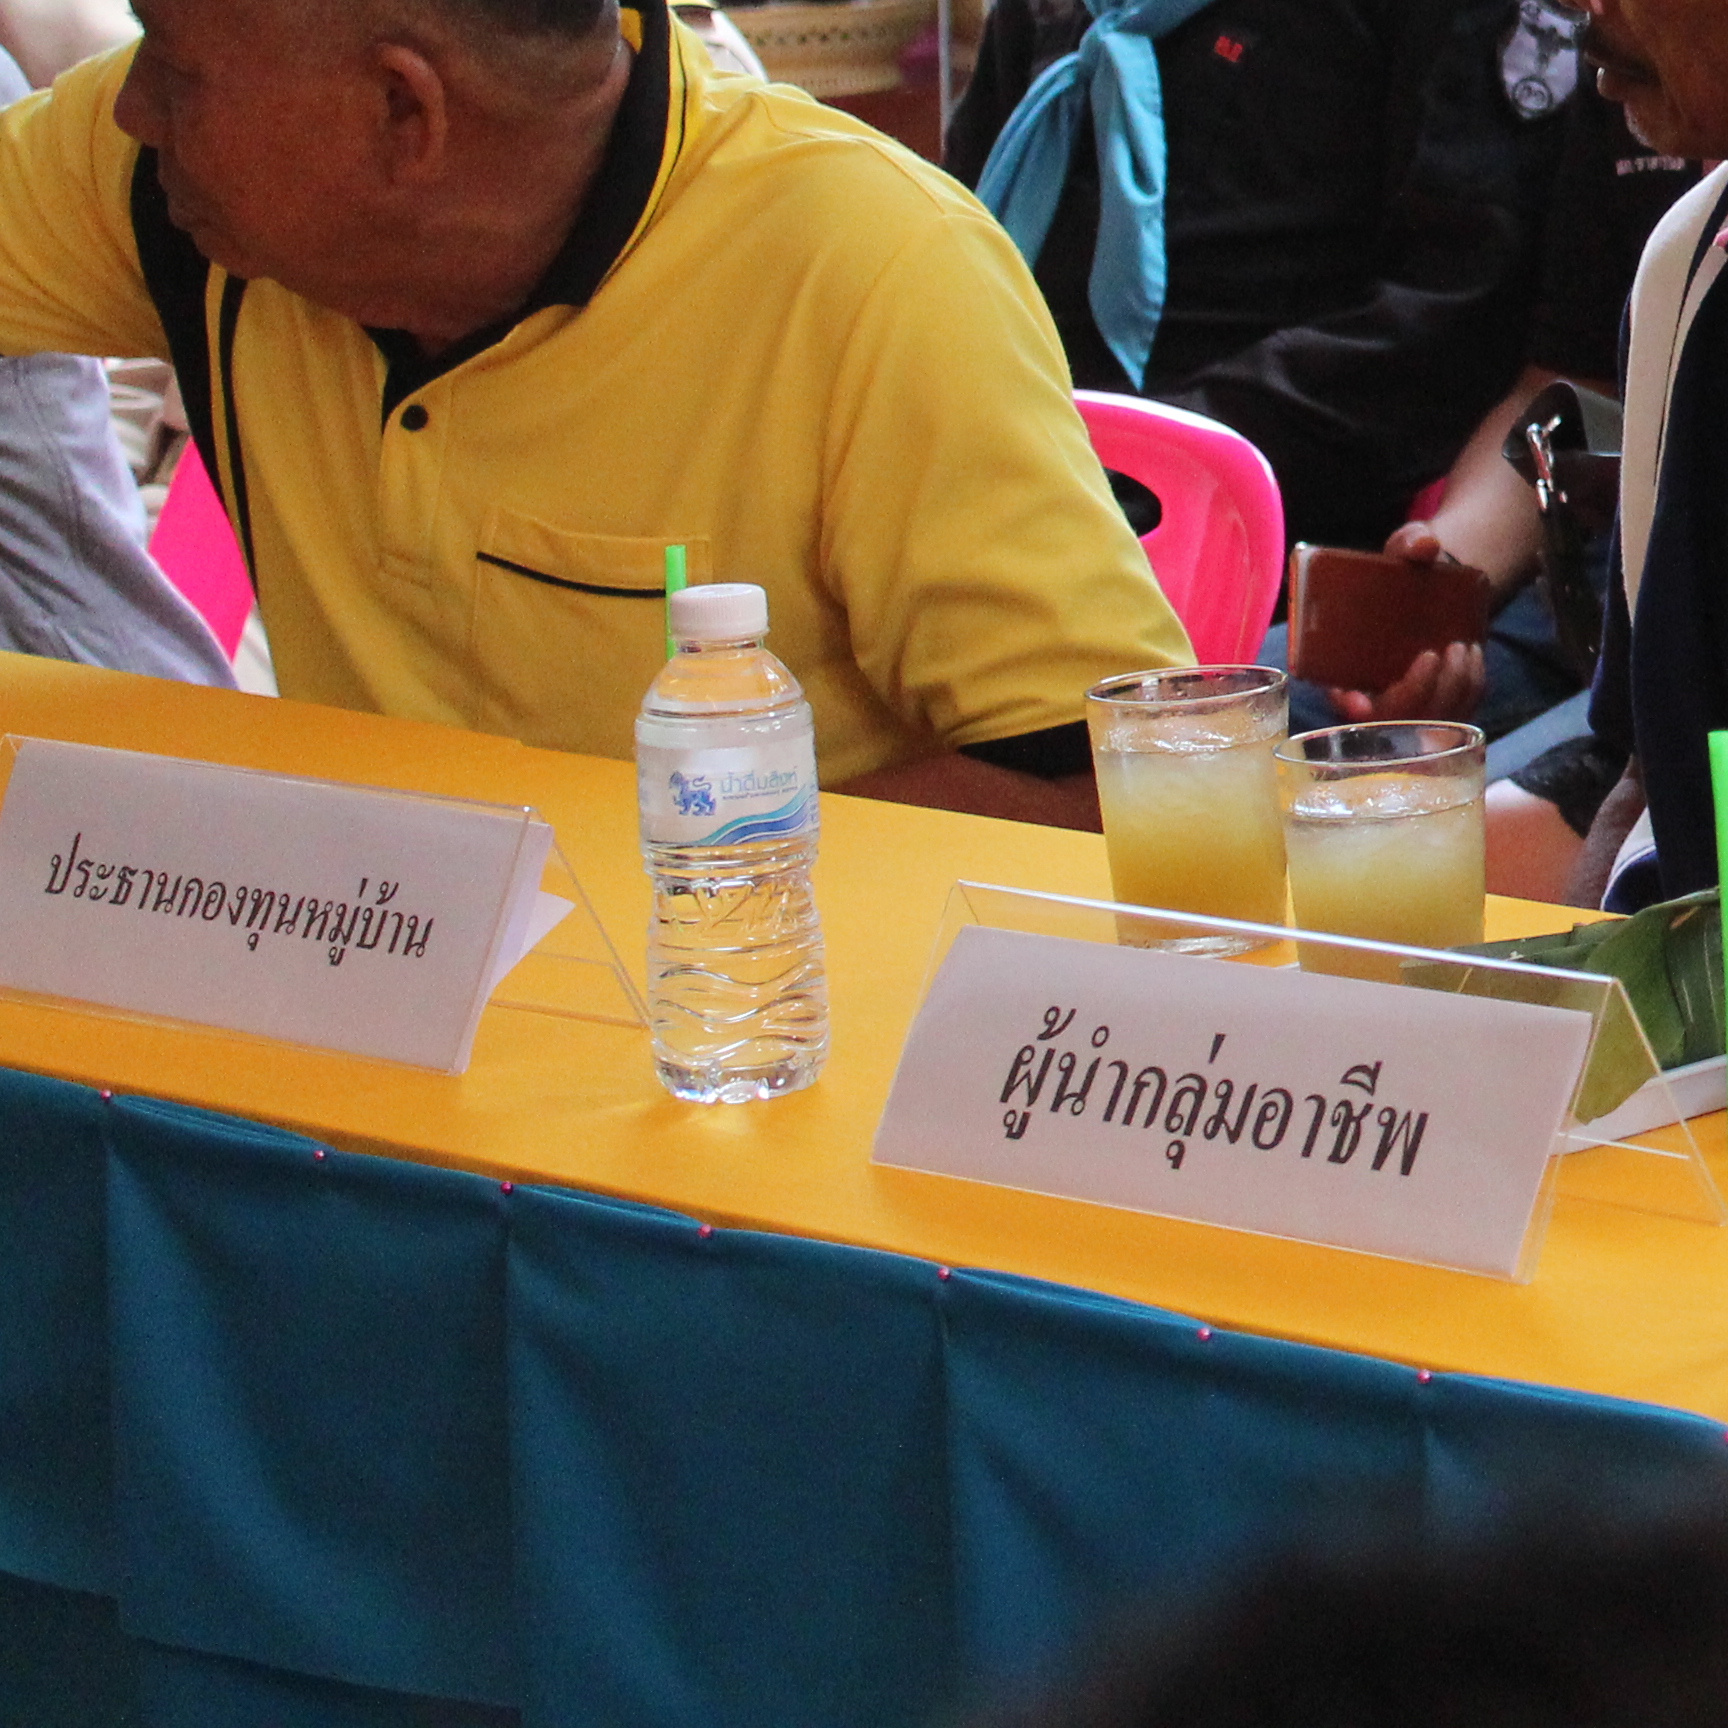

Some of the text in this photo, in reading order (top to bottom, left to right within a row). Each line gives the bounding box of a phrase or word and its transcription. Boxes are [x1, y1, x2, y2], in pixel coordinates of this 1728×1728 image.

[44, 832, 434, 967] ประธานกองทุนหมู่บ้าน
[999, 1005, 1429, 1177] ผู้นำกลุ่มอาชีพ
